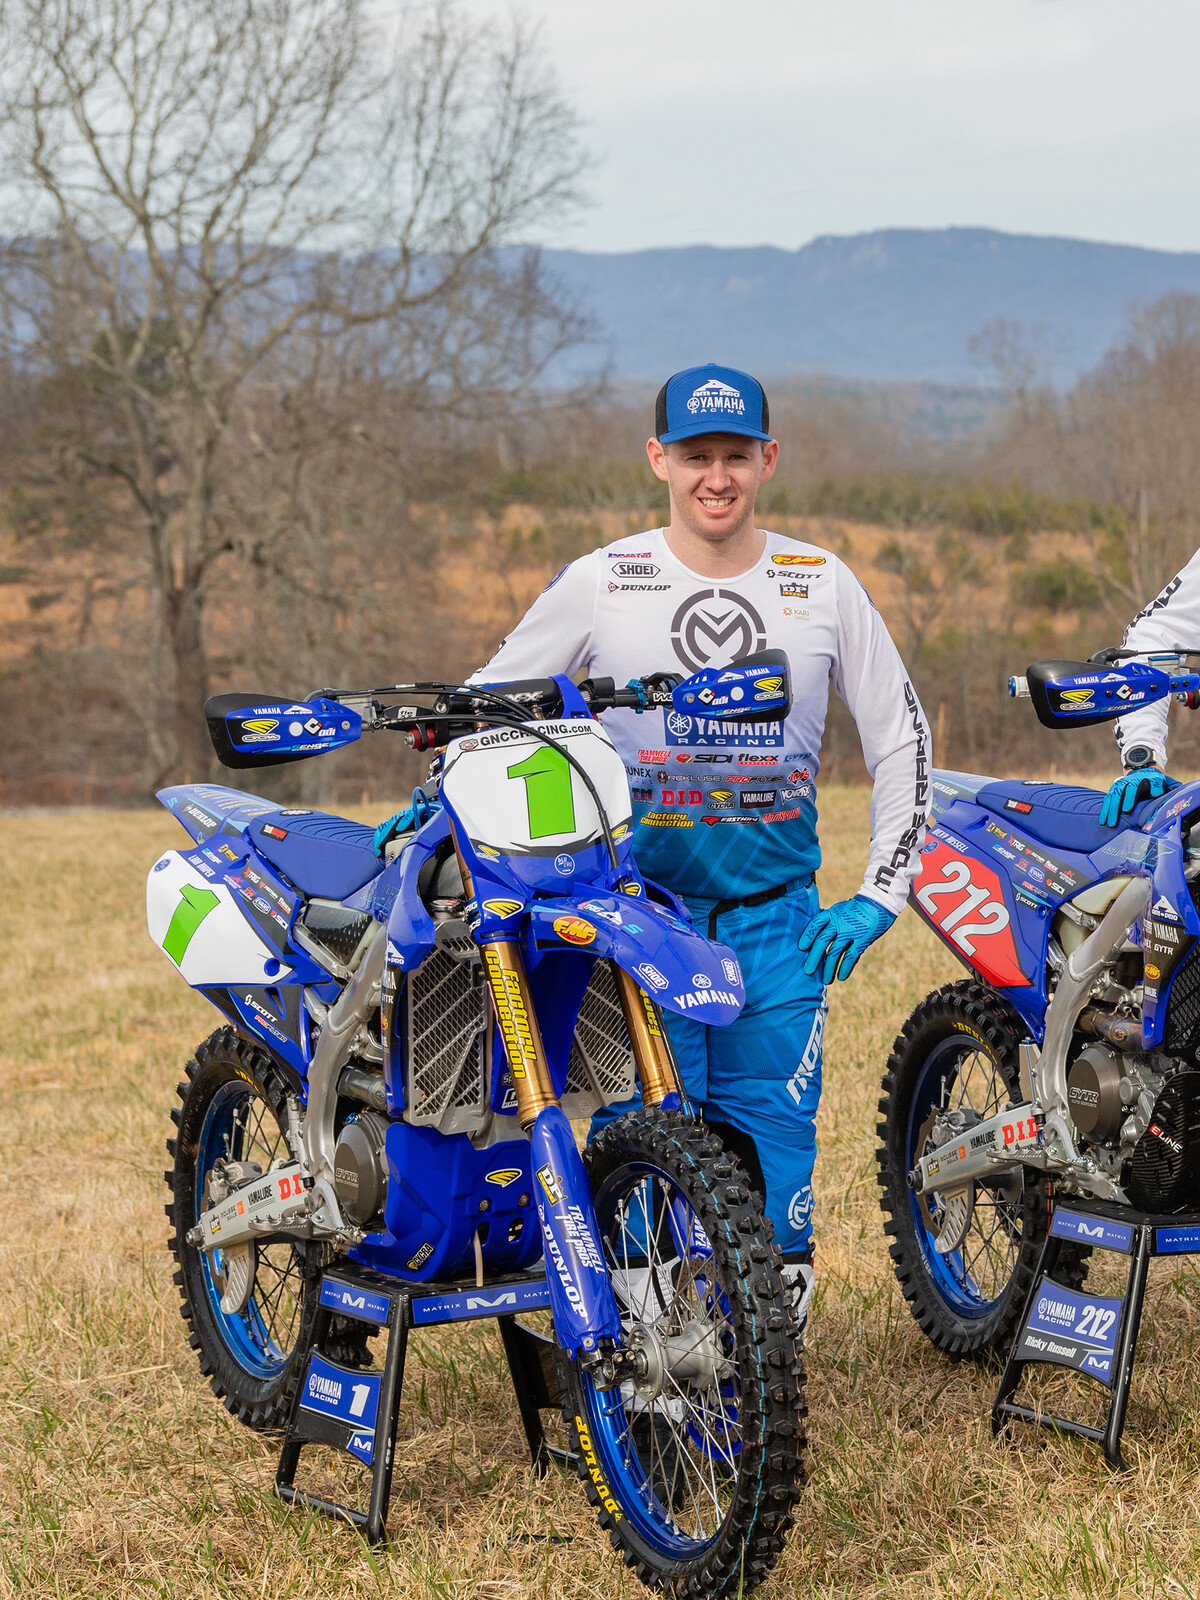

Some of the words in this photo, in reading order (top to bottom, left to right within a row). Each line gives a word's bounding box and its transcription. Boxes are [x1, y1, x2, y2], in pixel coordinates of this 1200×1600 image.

[690, 407, 744, 416] RACING
[699, 396, 746, 411] YAMAHA
[619, 564, 655, 576] SHOEI
[776, 570, 824, 580] SCOTT
[619, 583, 672, 592] DUNLOP
[744, 667, 771, 677] YAMAHA
[1073, 675, 1100, 686] YAMAHA
[253, 707, 282, 716] YAMAHA
[695, 718, 782, 736] YAMAHA
[693, 754, 734, 764] SIDI
[737, 753, 779, 762] flexx
[725, 775, 785, 784] PROFILTER
[506, 744, 577, 840] 1
[742, 791, 775, 804] YAMALUBE
[780, 784, 813, 805] VORTEX
[708, 802, 735, 810] CYCRA
[189, 806, 218, 829] DUNLOP
[915, 860, 1011, 958] 212
[1019, 895, 1039, 909] SCOTT
[161, 883, 222, 968] 1
[552, 917, 598, 941] FMF
[1153, 921, 1180, 944] YAMAHA
[1153, 943, 1175, 956] GYTR
[641, 964, 667, 988] SHOEI
[673, 989, 741, 1010] YAMAHA
[250, 999, 279, 1024] SCOTT
[1069, 1086, 1099, 1104] GYTR
[969, 1129, 997, 1150] YAMALUBE
[335, 1168, 358, 1184] GYTR
[927, 1160, 939, 1171] DP
[540, 1166, 563, 1199] DP
[247, 1184, 274, 1206] YAMALUBE
[211, 1218, 221, 1229] DP
[1057, 1220, 1076, 1229] MATRIX
[1106, 1232, 1127, 1241] MATRIX
[567, 1204, 606, 1274] TRAMMELL
[542, 1223, 588, 1319] DUNLOP
[324, 1290, 341, 1300] MATRIX
[367, 1302, 386, 1313] MATRIX
[422, 1302, 461, 1313] MATRIX
[523, 1290, 551, 1298] MATR
[1046, 1300, 1076, 1322] YAMAHA
[1037, 1314, 1072, 1328] RACING
[1074, 1304, 1117, 1341] 212
[1024, 1335, 1047, 1352] Ricky
[1046, 1341, 1077, 1358] Russell
[316, 1375, 343, 1400] YAMAHA
[309, 1391, 339, 1406] RACING
[349, 1383, 371, 1418] 1
[574, 1415, 620, 1516] DUNLOP
